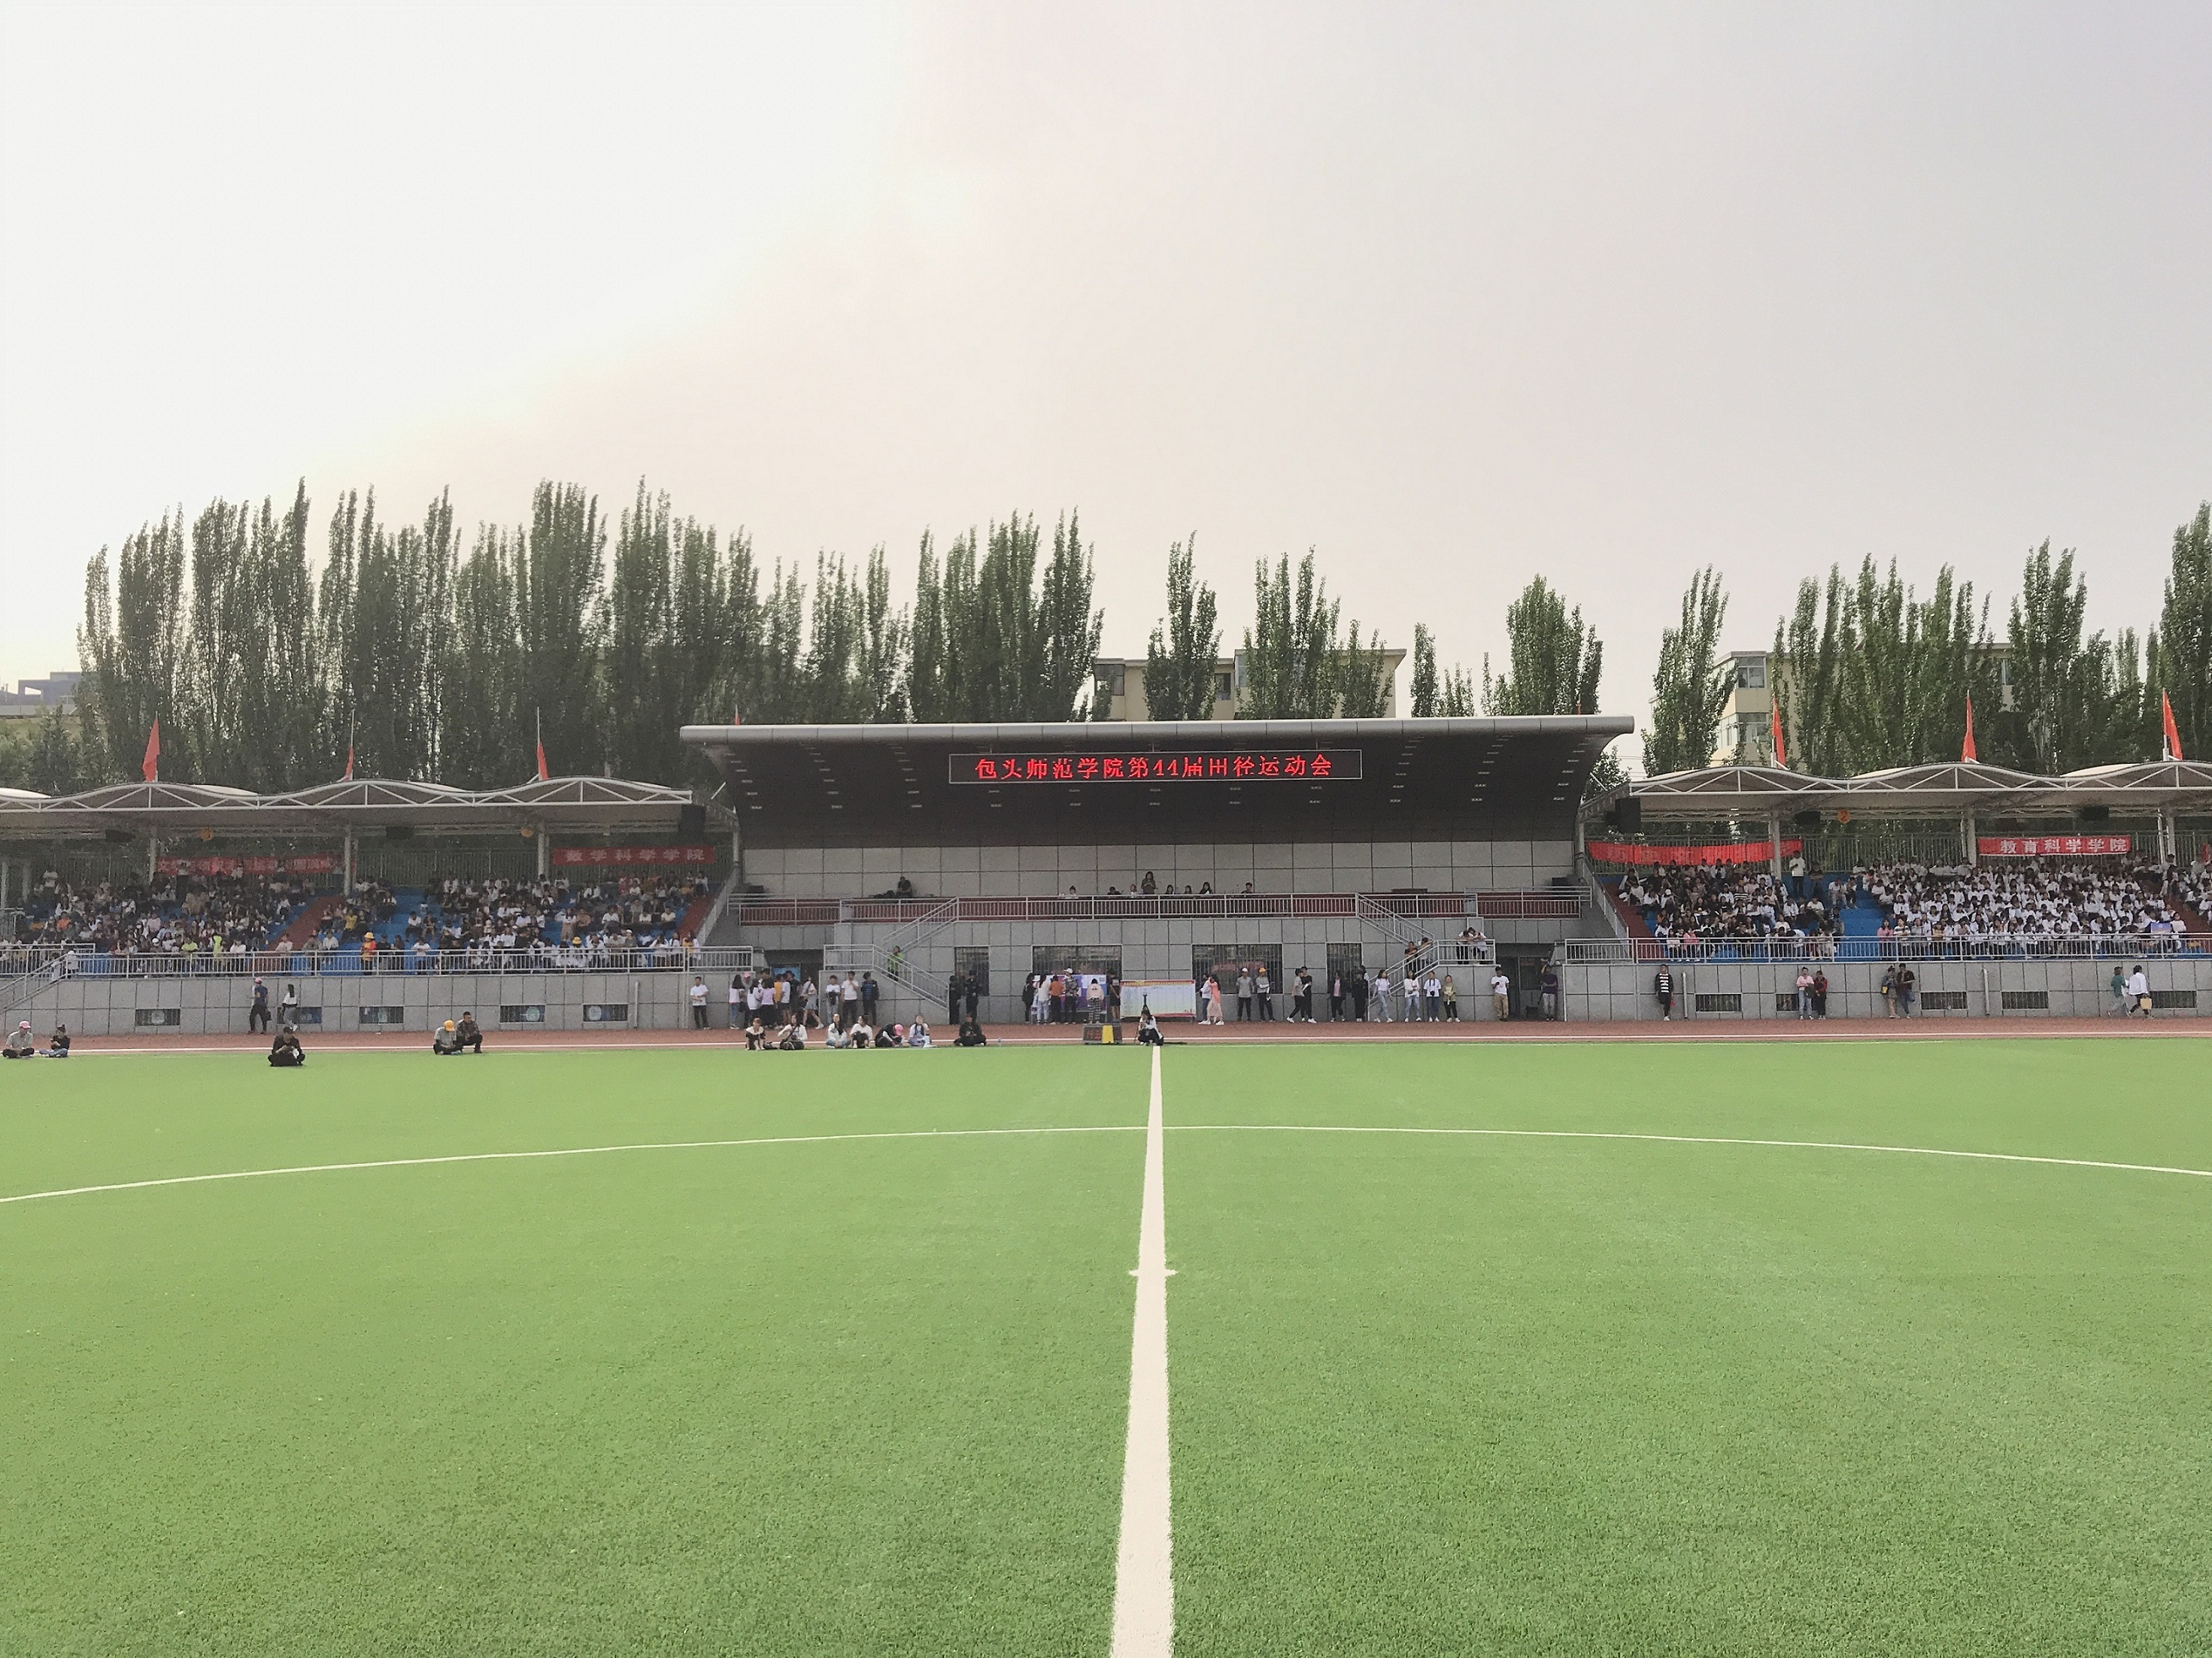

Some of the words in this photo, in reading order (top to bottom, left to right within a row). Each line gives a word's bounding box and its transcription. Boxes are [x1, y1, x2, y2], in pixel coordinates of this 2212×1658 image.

[2001, 838, 2127, 853] 教育科学学院
